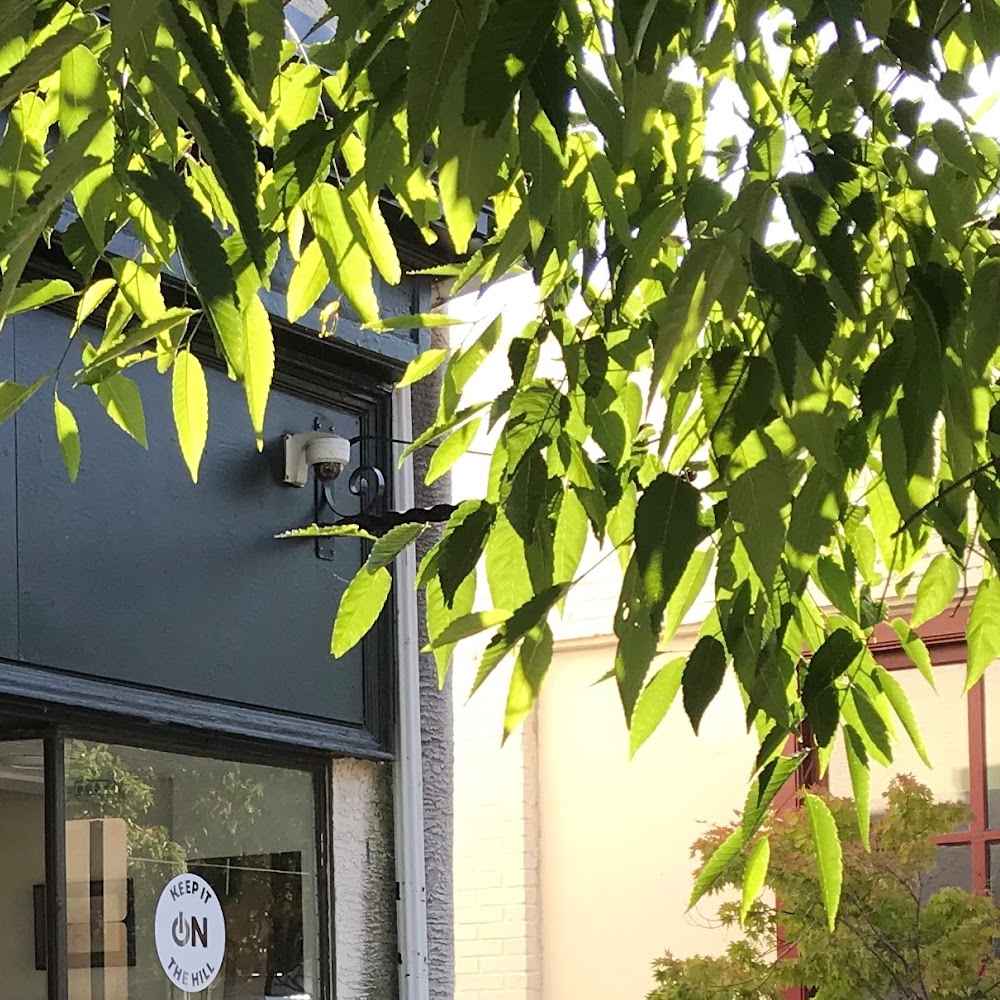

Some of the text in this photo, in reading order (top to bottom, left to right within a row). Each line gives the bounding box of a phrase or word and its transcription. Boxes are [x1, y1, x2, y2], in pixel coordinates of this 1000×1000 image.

[170, 880, 212, 904] KEEP IT
[172, 911, 208, 948] ON
[168, 957, 215, 987] THE HILL
